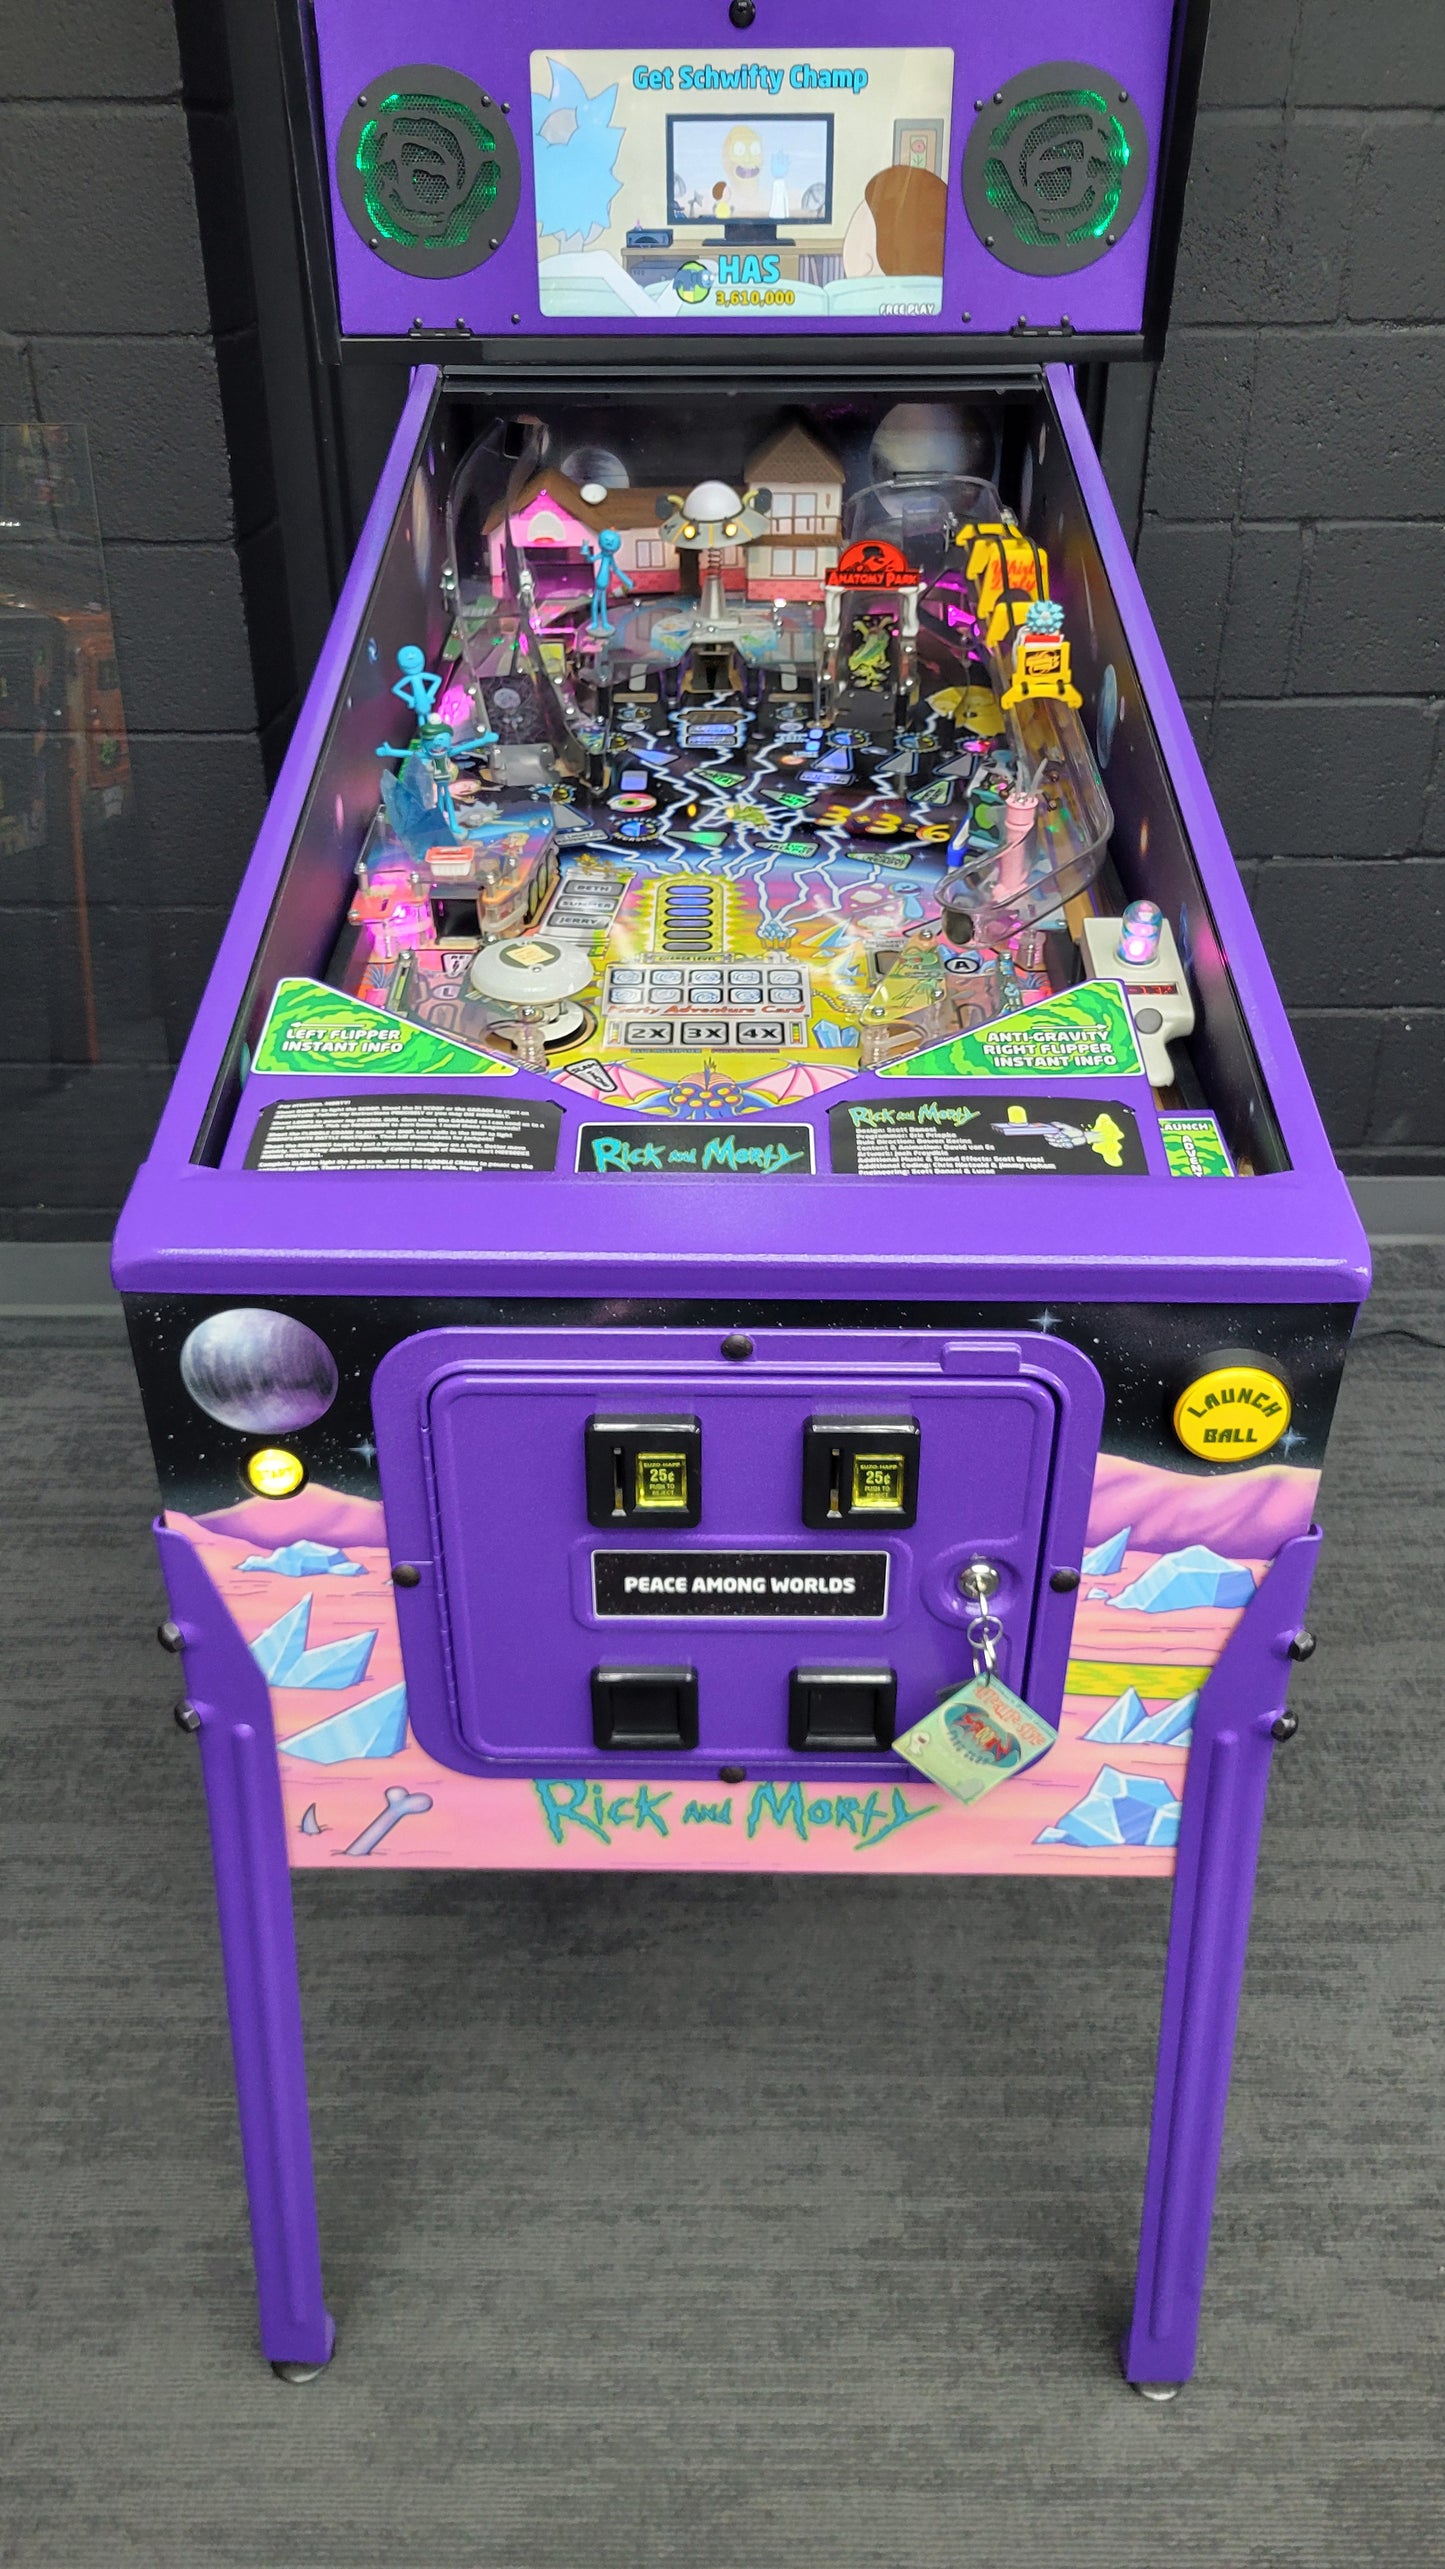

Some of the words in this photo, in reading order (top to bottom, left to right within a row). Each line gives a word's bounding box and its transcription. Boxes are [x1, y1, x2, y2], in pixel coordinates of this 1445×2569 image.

[633, 65, 673, 91] Get
[679, 64, 784, 94] Schwifty
[790, 63, 869, 94] Champ
[717, 254, 781, 285] HAS
[715, 290, 795, 307] 3,610,000
[879, 303, 906, 316] FREE
[907, 303, 935, 316] PLAY
[828, 570, 884, 586] ANATOMY
[885, 571, 918, 587] PARK
[815, 804, 852, 827] 3
[865, 812, 903, 835] 3
[916, 824, 951, 843] 6
[954, 961, 971, 970] A
[662, 1004, 756, 1014] Adventure
[760, 1004, 806, 1014] Card
[286, 1029, 327, 1040] LEFT
[330, 1030, 401, 1041] FLIPPER
[631, 1028, 666, 1039] 2X
[688, 1028, 722, 1038] 3X
[742, 1028, 778, 1038] 4X
[986, 1030, 1110, 1043] ANTI-GRAVITY
[282, 1041, 359, 1053] INSTANT
[362, 1042, 404, 1053] INFO
[983, 1043, 1038, 1056] RIGHT
[1041, 1043, 1113, 1054] FLIPPER
[994, 1055, 1071, 1068] INSTANT
[1074, 1055, 1117, 1067] INFO
[848, 1106, 896, 1128] Rick
[917, 1101, 981, 1127] Morty
[592, 1136, 666, 1172] Rick
[702, 1135, 804, 1174] Morty
[1187, 1388, 1283, 1418] LAUNCH
[1203, 1428, 1258, 1443] BALL
[650, 1468, 675, 1482] 25¢
[865, 1470, 891, 1485] 25¢
[624, 1576, 688, 1594] PEACE
[690, 1576, 767, 1594] AMONG
[770, 1576, 857, 1595] WORLDS
[533, 1778, 672, 1845] Rick
[746, 1781, 940, 1851] Morty
